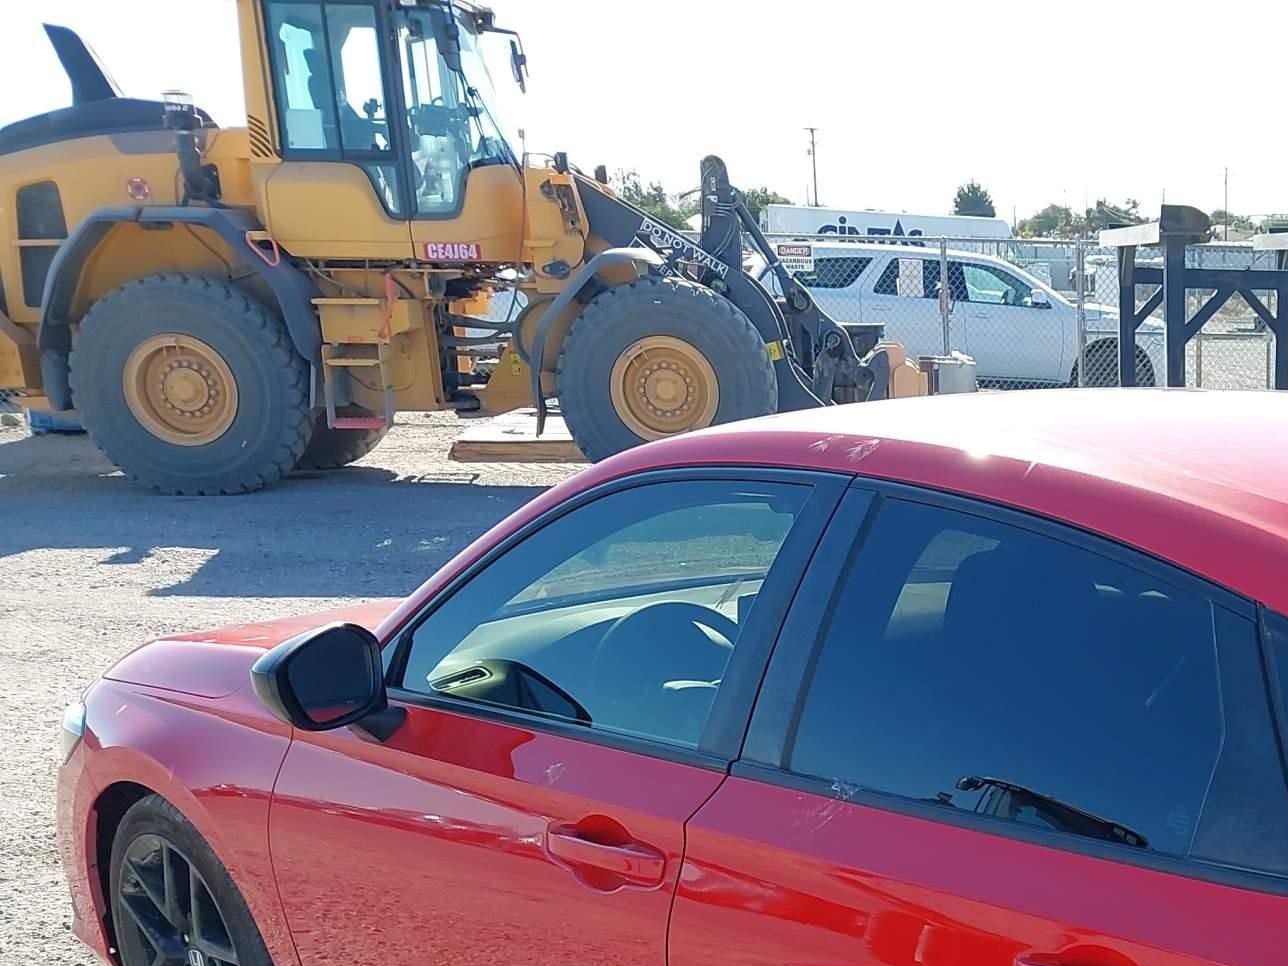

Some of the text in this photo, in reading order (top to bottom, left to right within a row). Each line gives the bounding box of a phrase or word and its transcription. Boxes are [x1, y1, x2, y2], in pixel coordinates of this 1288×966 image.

[643, 221, 662, 237] DO
[663, 234, 691, 254] NOT
[692, 248, 726, 276] WALK
